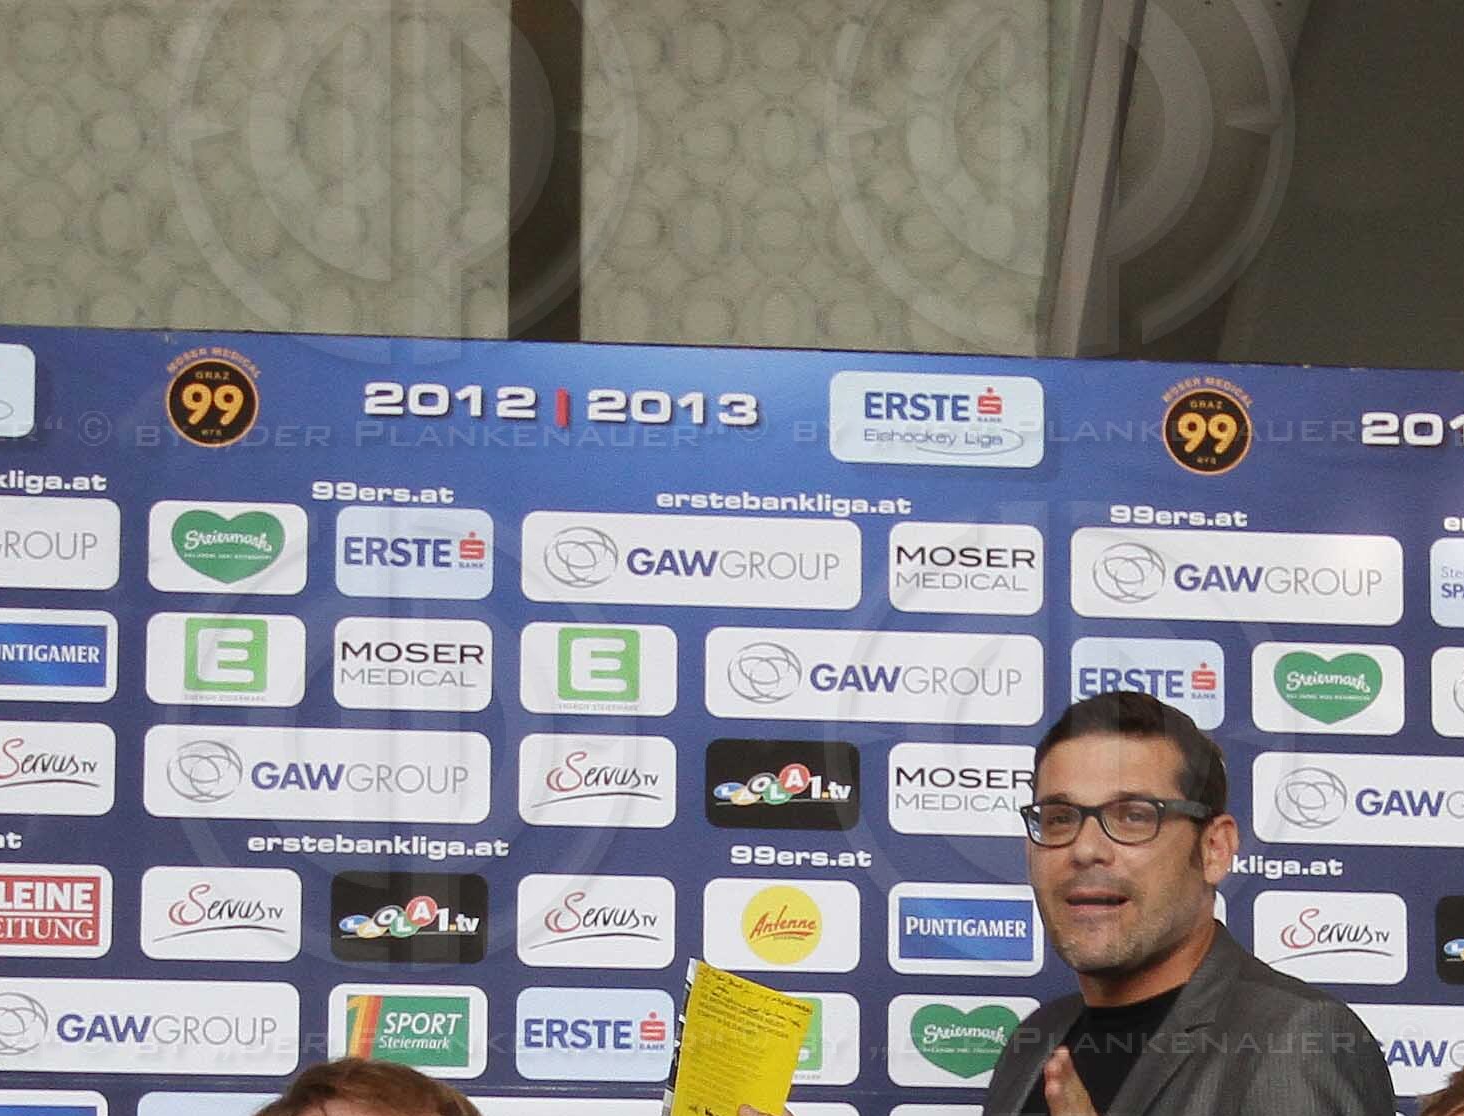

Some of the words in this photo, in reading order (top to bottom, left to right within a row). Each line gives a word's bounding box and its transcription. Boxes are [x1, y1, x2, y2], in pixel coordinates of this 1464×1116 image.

[182, 383, 244, 426] 99
[364, 381, 537, 418] 2012
[587, 389, 758, 426] 2013
[864, 391, 970, 421] ERSTE
[863, 427, 958, 447] Eishockey
[965, 431, 1003, 448] Liga
[1177, 412, 1238, 454] 99
[312, 480, 454, 504] 99ers.at
[656, 490, 913, 518] erstebankliga.at
[1109, 504, 1248, 528] 99ers.at
[344, 536, 452, 568] ERSTE
[896, 546, 1035, 568] MOSER
[896, 572, 1029, 592] MEDICAL
[341, 641, 485, 665] MOSER
[340, 668, 477, 688] MEDICAL
[1079, 668, 1184, 698] ERSTE
[895, 767, 1034, 789] MOSER
[248, 834, 510, 861] erstebankliga.at
[730, 845, 872, 868] 99ers.at
[905, 915, 1026, 938] PUNTIGAMER
[383, 1012, 462, 1036] SPORT
[524, 1019, 633, 1049] ERSTE
[379, 1034, 451, 1050] Steiermark
